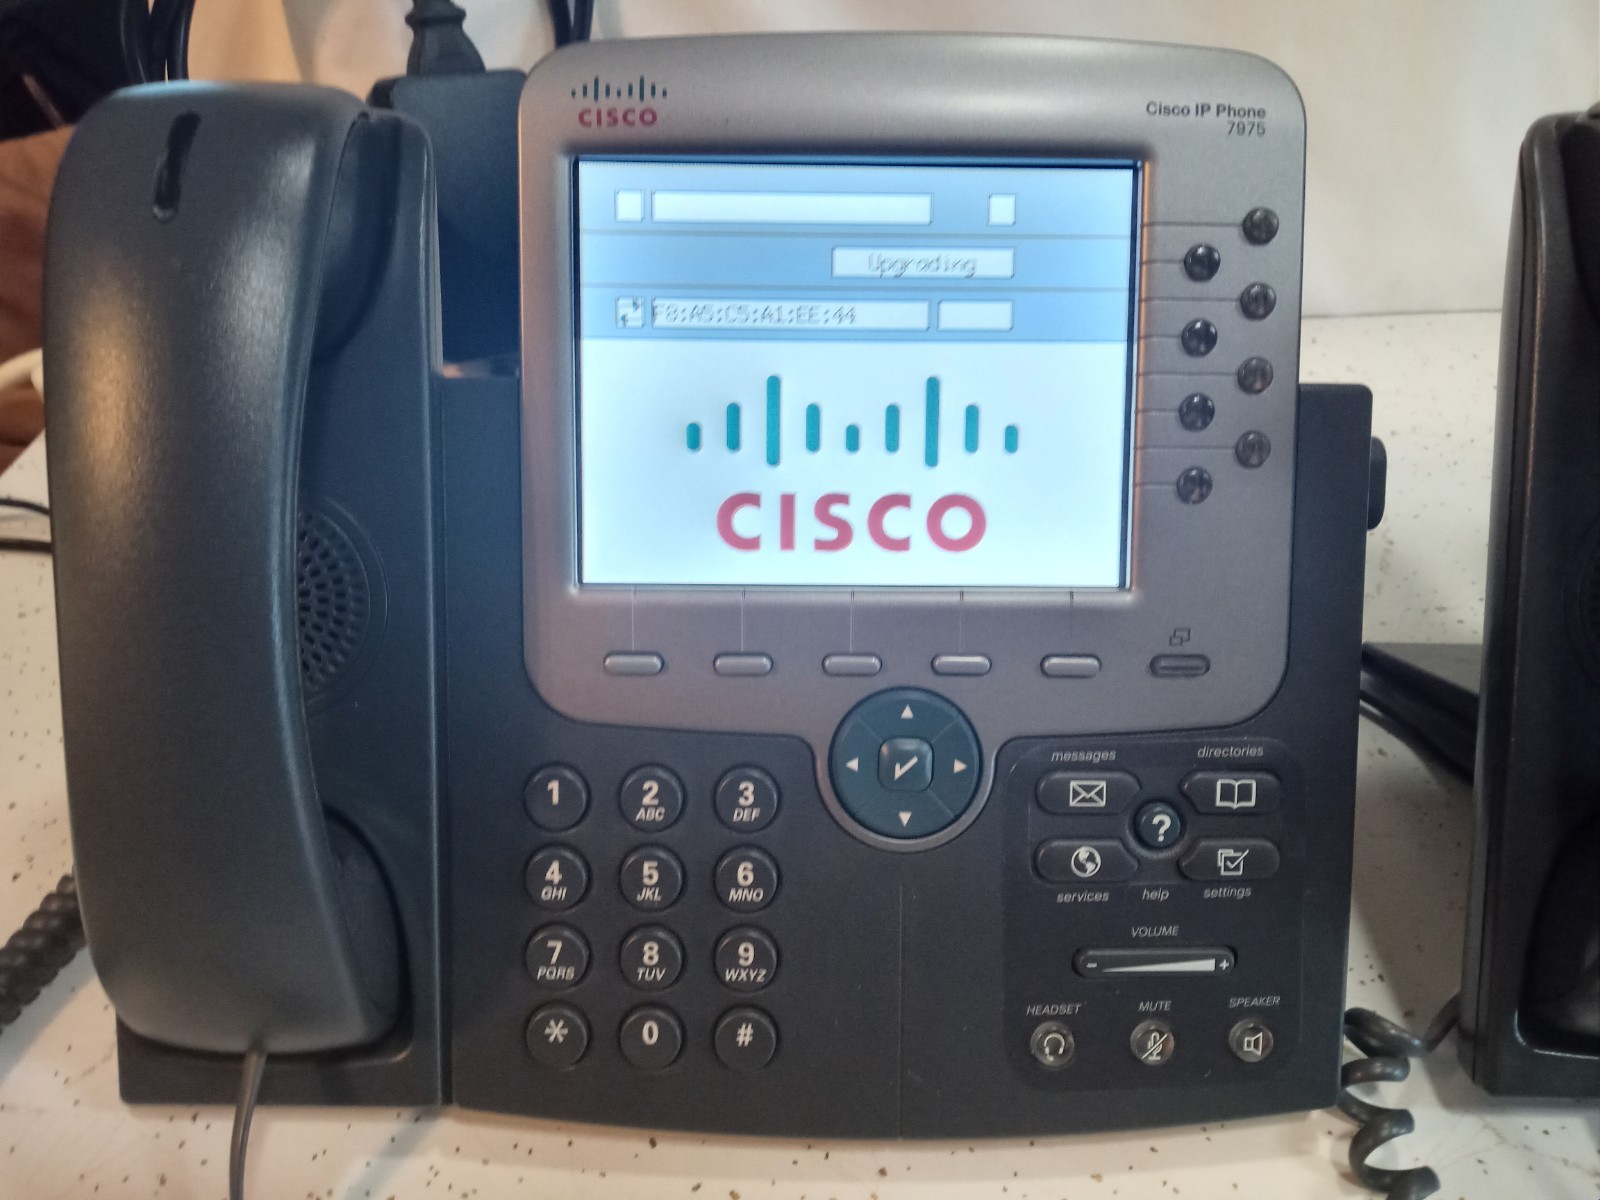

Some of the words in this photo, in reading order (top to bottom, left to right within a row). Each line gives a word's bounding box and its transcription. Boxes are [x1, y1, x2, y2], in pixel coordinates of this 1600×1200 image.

[578, 108, 657, 127] CISCO
[1146, 101, 1190, 116] Cisco
[1195, 103, 1211, 117] IP
[1216, 103, 1266, 119] Phone
[1228, 120, 1265, 136] 7975
[867, 252, 977, 278] Upgrading
[716, 492, 987, 552] CISCO
[1052, 750, 1116, 763] messages
[1197, 745, 1264, 758] directories
[547, 780, 559, 805] 1
[642, 781, 659, 805] 2
[738, 781, 755, 806] 3
[636, 808, 665, 821] ABC
[733, 808, 760, 821] DEF
[545, 860, 562, 885] 4
[642, 861, 659, 886] 5
[737, 861, 754, 886] 6
[541, 886, 567, 901] GHI
[637, 888, 661, 901] JKL
[728, 888, 764, 902] MNO
[1056, 891, 1109, 903] services
[1142, 887, 1169, 901] help
[1203, 886, 1251, 899] settings
[1131, 925, 1179, 938] VOLUME
[547, 940, 562, 964] 7
[642, 941, 659, 966] 8
[737, 941, 755, 967] 9
[537, 966, 575, 980] PQRS
[637, 967, 666, 981] TUV
[725, 968, 766, 983] WXYZ
[1026, 1003, 1081, 1015] HEADSET
[1138, 1001, 1172, 1012] MUTE
[1229, 996, 1281, 1008] SPEAKER
[642, 1020, 659, 1046] 0
